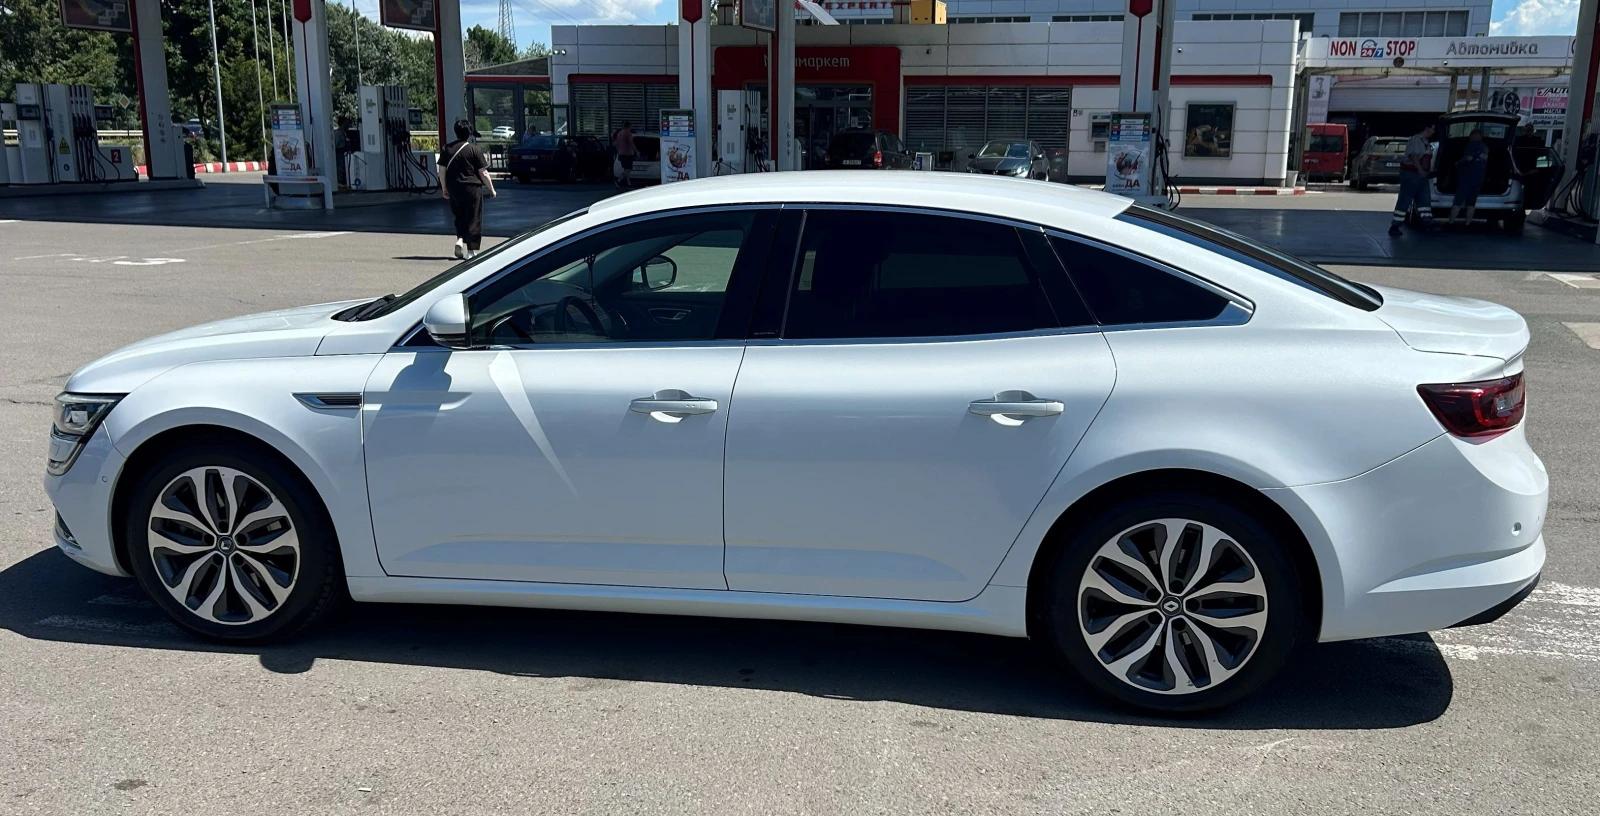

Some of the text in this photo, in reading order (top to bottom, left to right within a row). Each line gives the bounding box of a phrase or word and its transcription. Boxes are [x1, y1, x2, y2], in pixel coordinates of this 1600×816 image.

[1330, 41, 1357, 56] NON
[1386, 40, 1416, 56] STOP
[1446, 41, 1539, 56] Автомивка
[113, 151, 119, 162] 2
[676, 172, 690, 181] ДА
[1124, 179, 1140, 189] ДА
